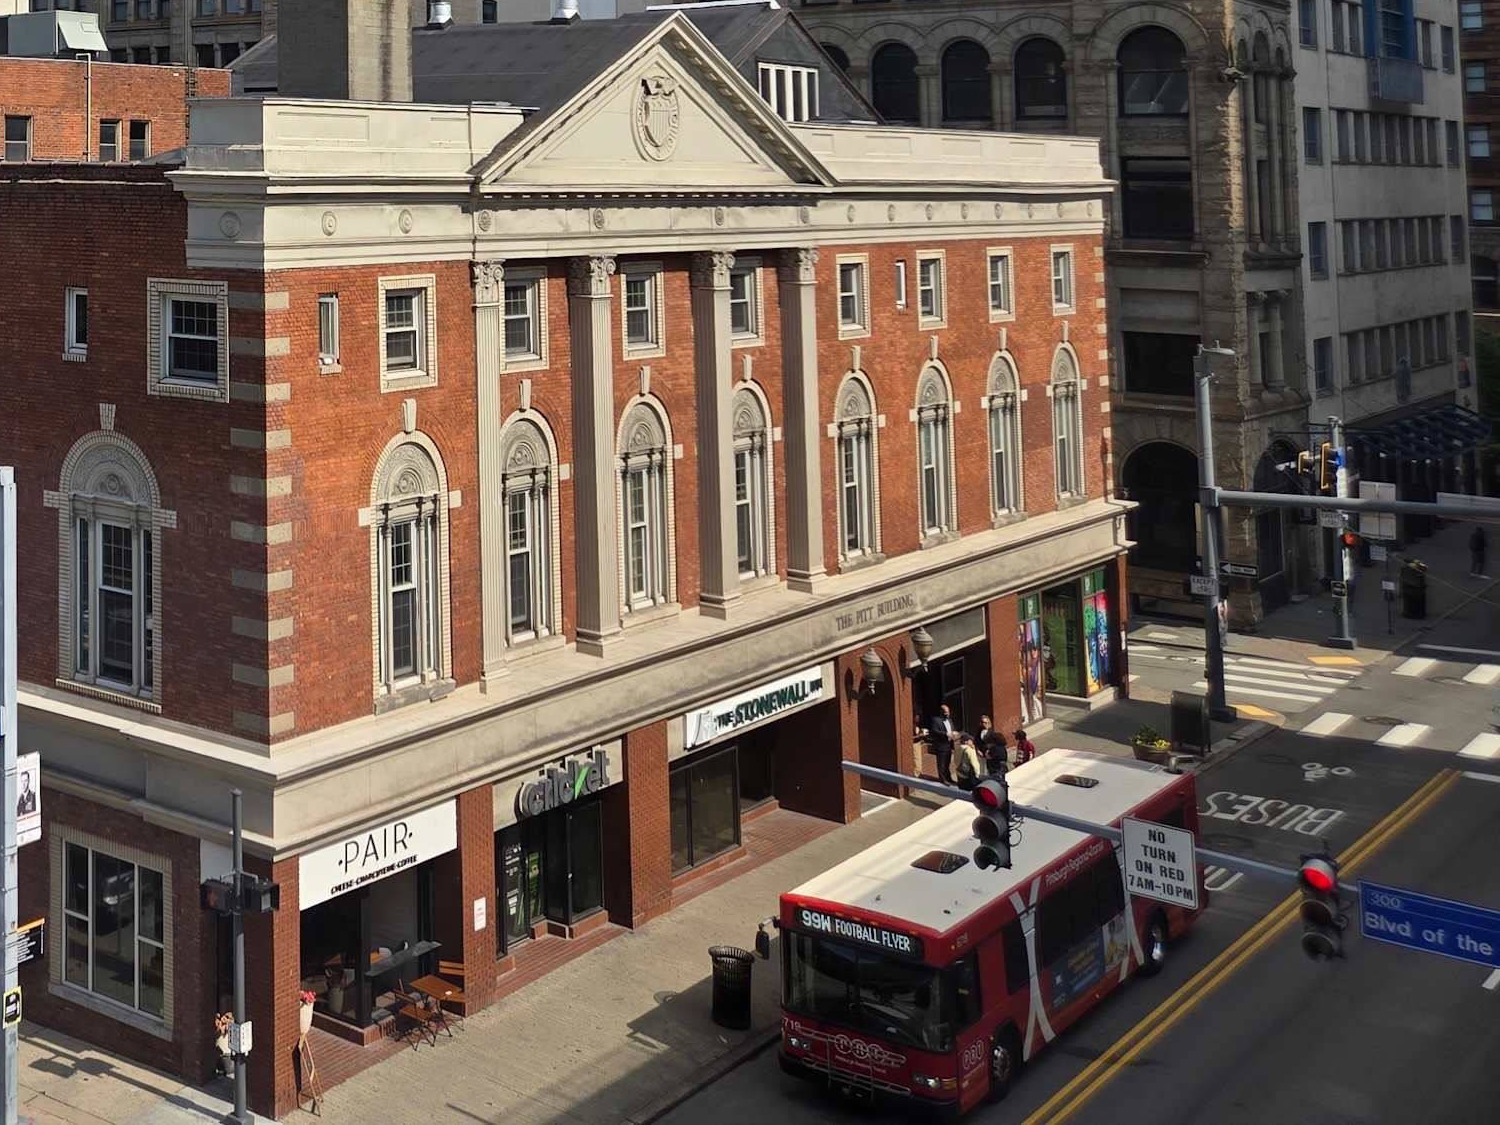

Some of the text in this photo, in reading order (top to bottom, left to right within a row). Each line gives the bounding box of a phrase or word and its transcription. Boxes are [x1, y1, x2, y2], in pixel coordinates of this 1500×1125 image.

[836, 593, 914, 631] THE PITT BUILDING
[733, 680, 809, 728] STONEWALL
[1196, 791, 1345, 836] BUSES
[1141, 844, 1176, 863] TURN
[1148, 829, 1165, 844] NO
[1135, 859, 1185, 882] ON RED
[1369, 891, 1401, 909] 300
[802, 909, 911, 952] 99W FOOTBALL FLYER
[1364, 911, 1493, 956] Blvd of the
